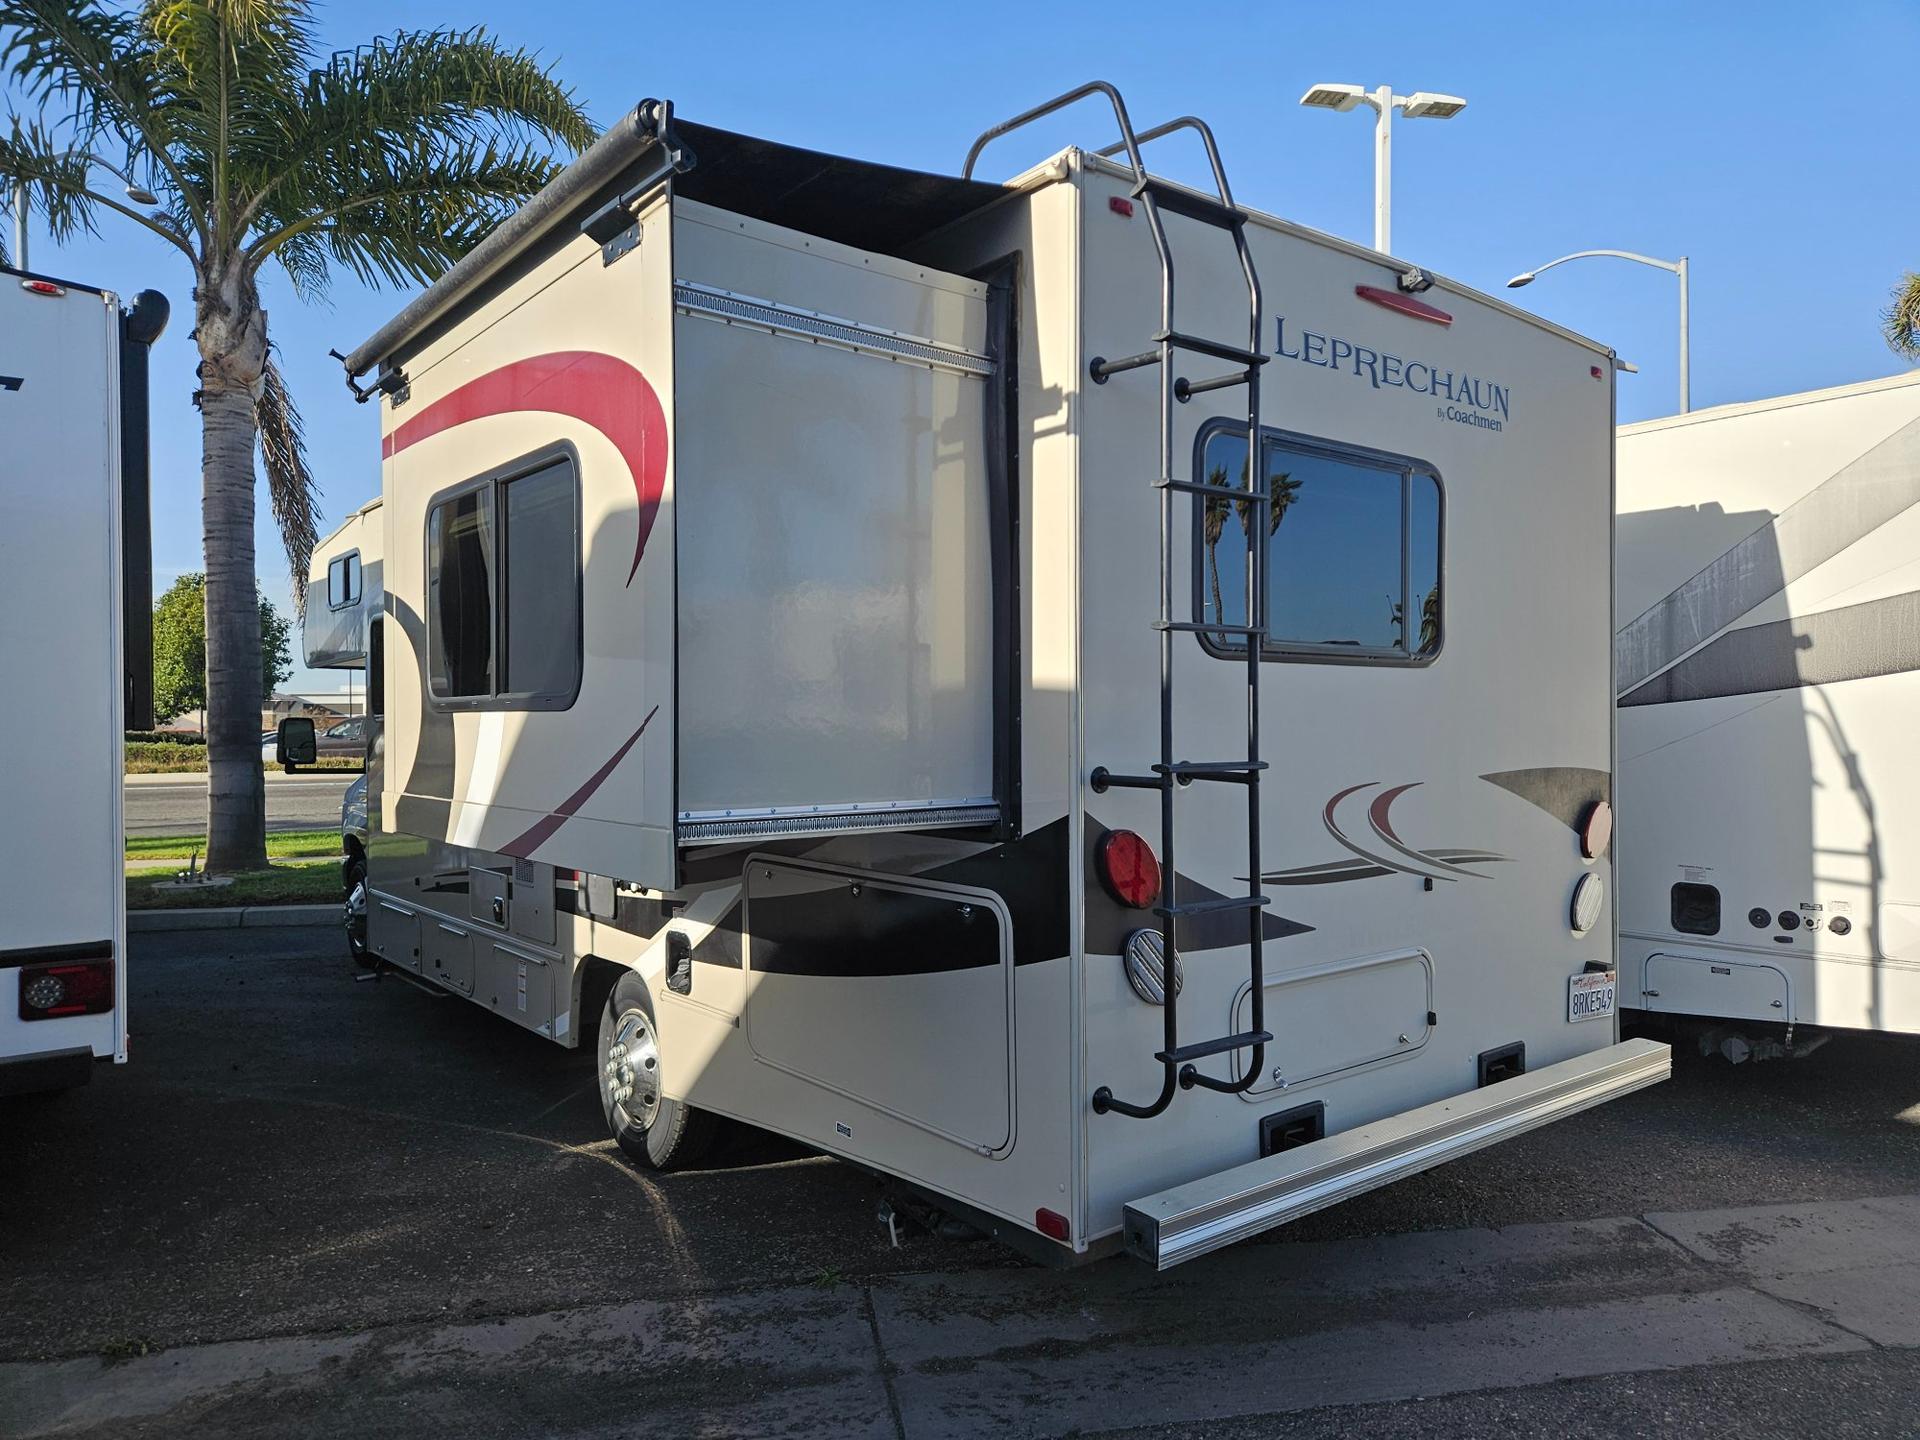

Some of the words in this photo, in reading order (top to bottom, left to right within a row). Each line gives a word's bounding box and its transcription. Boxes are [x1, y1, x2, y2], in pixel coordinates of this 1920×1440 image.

[1274, 315, 1512, 421] LEPRECHAUN
[1437, 407, 1446, 421] By
[1446, 406, 1503, 432] Coachmen
[1572, 988, 1613, 1015] 8RKE549
